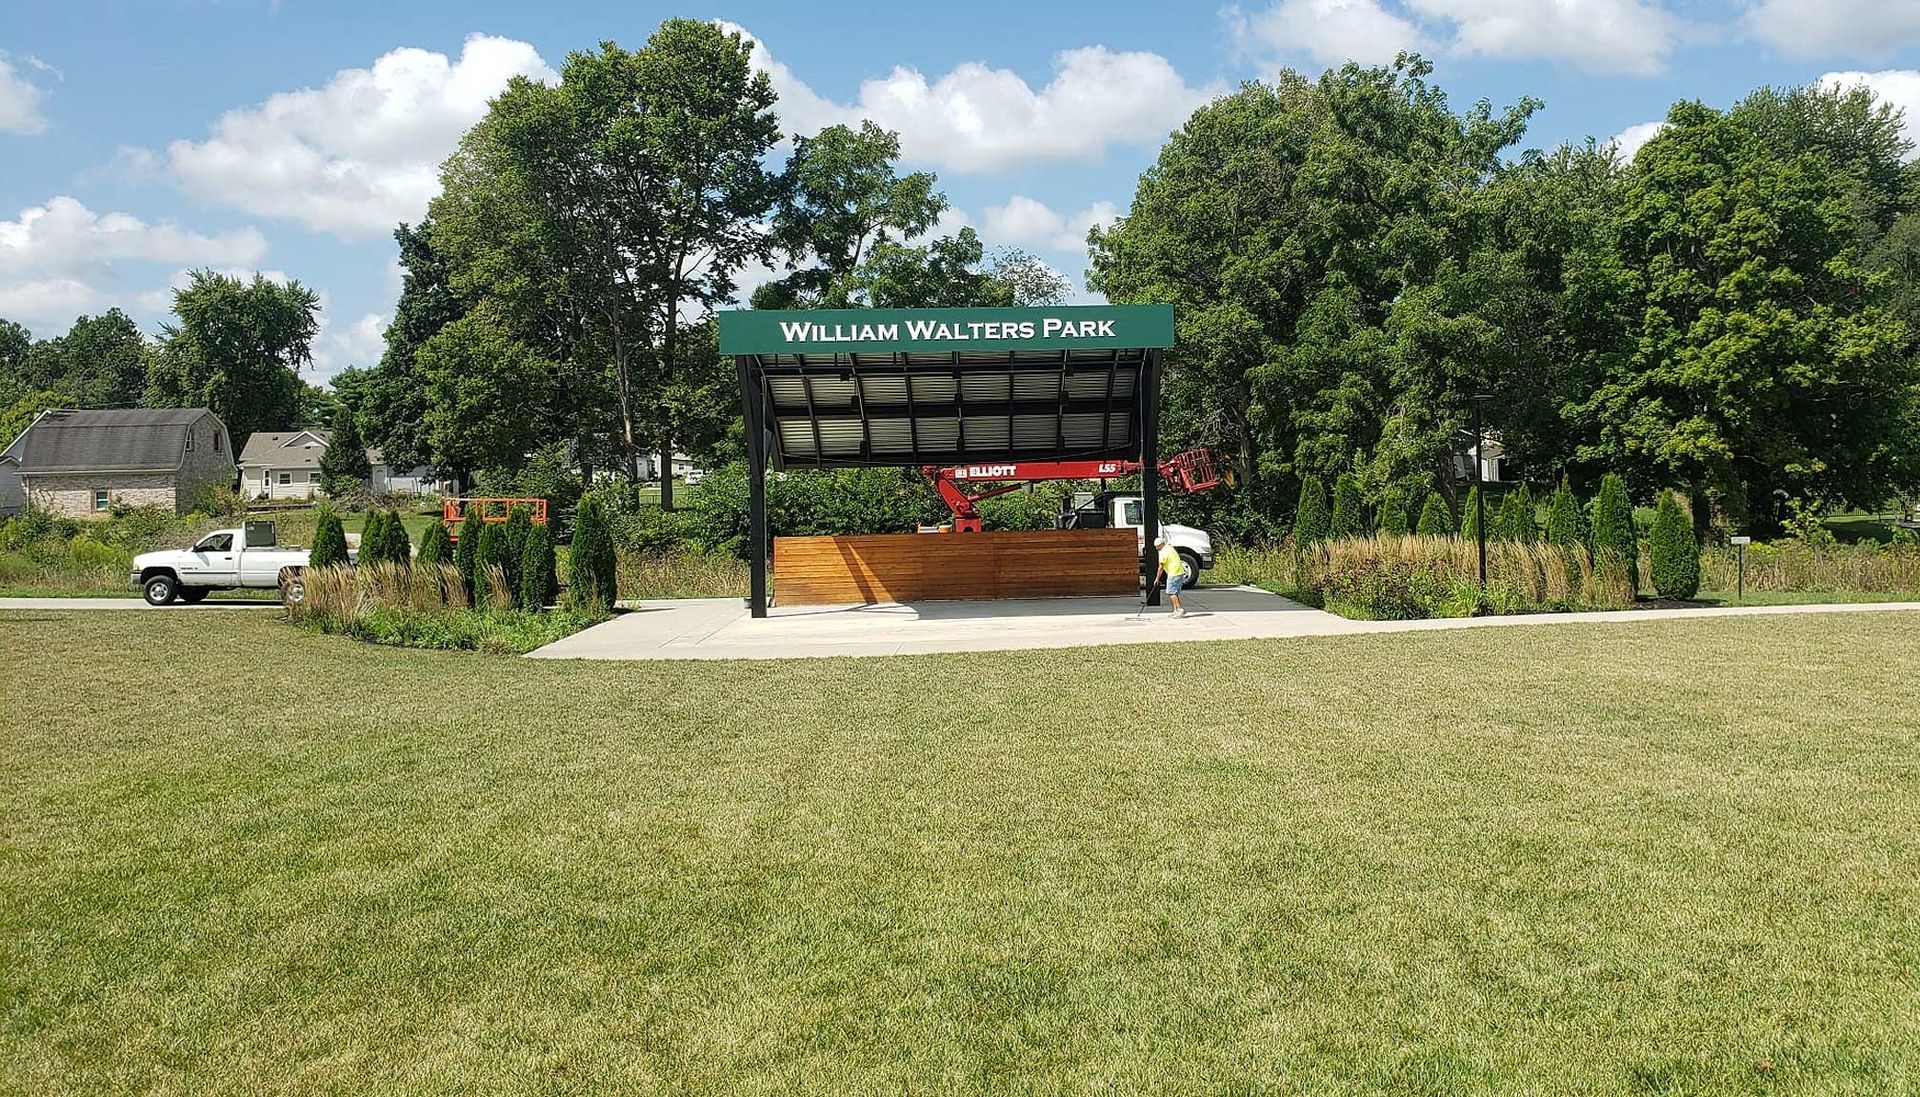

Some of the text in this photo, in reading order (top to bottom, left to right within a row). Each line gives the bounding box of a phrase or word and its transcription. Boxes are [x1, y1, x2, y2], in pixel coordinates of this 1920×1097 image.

[779, 318, 1117, 342] WILLIAM WALTERS PARK
[969, 465, 1017, 477] ELLIOTT
